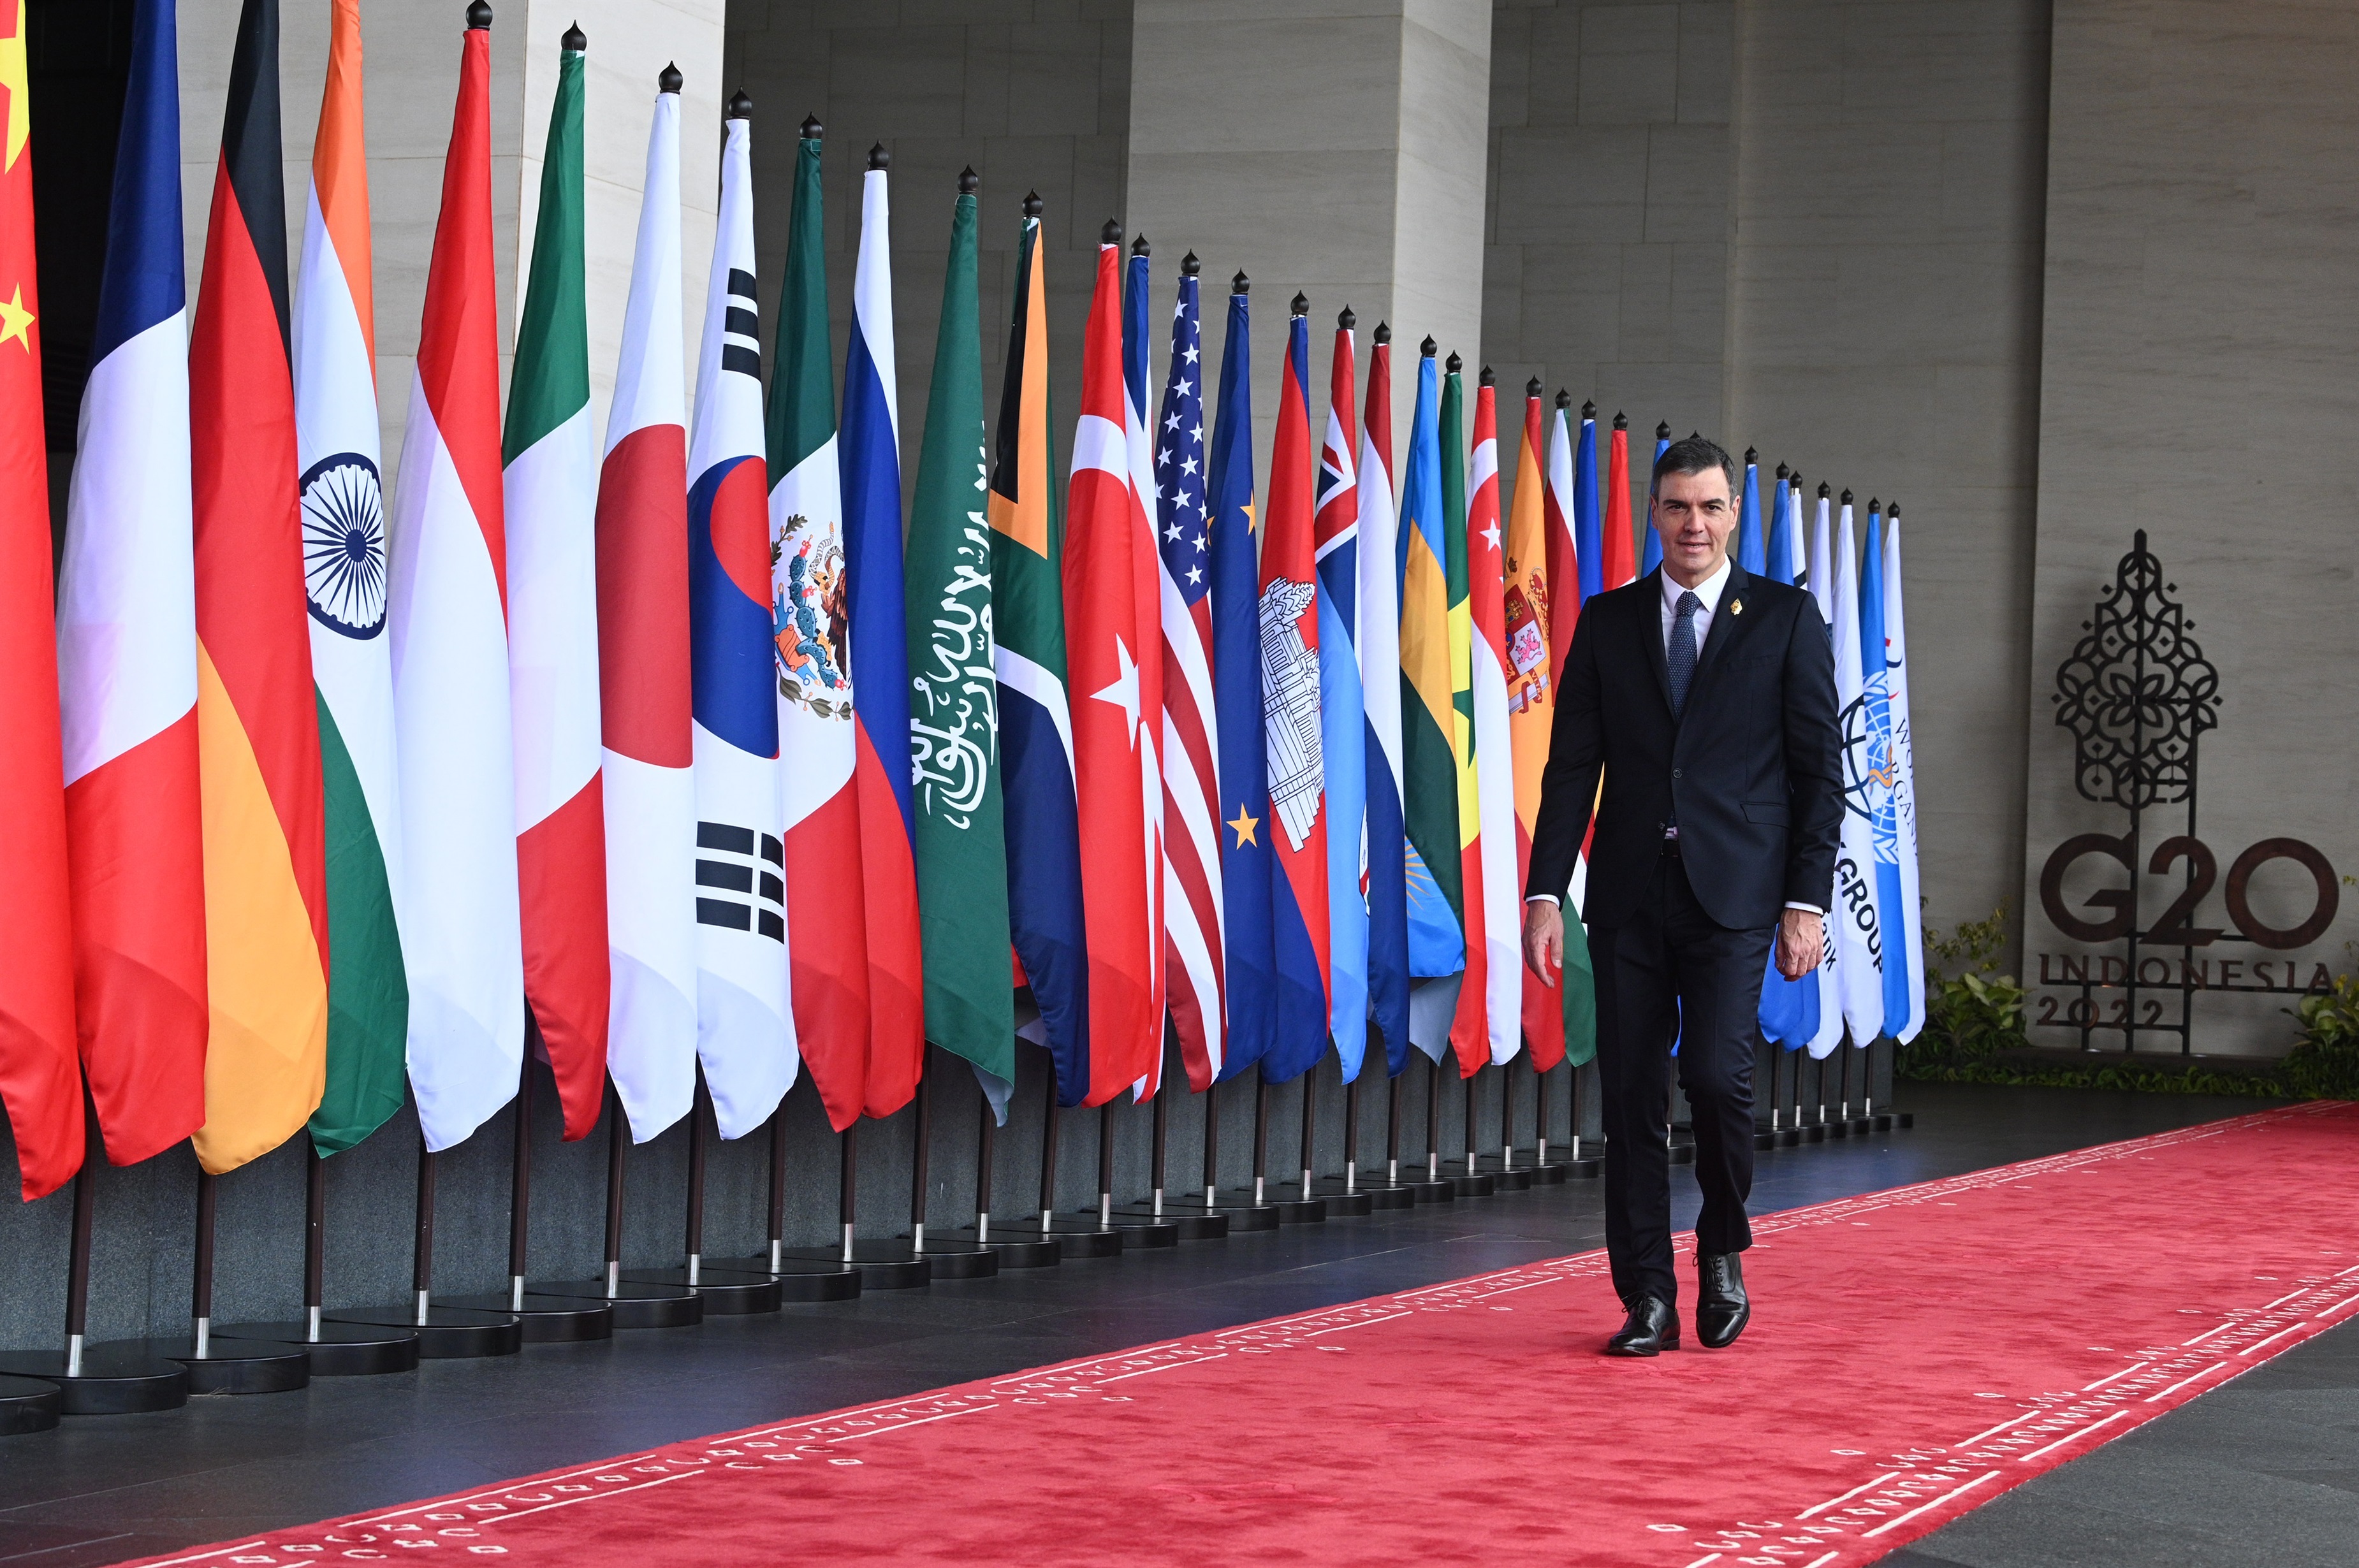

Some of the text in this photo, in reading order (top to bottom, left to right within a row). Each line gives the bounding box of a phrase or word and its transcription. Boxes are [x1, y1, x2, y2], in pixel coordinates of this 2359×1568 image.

[2040, 831, 2339, 950] G20
[2039, 954, 2336, 995] INDONESIA
[2036, 996, 2163, 1029] 2022
